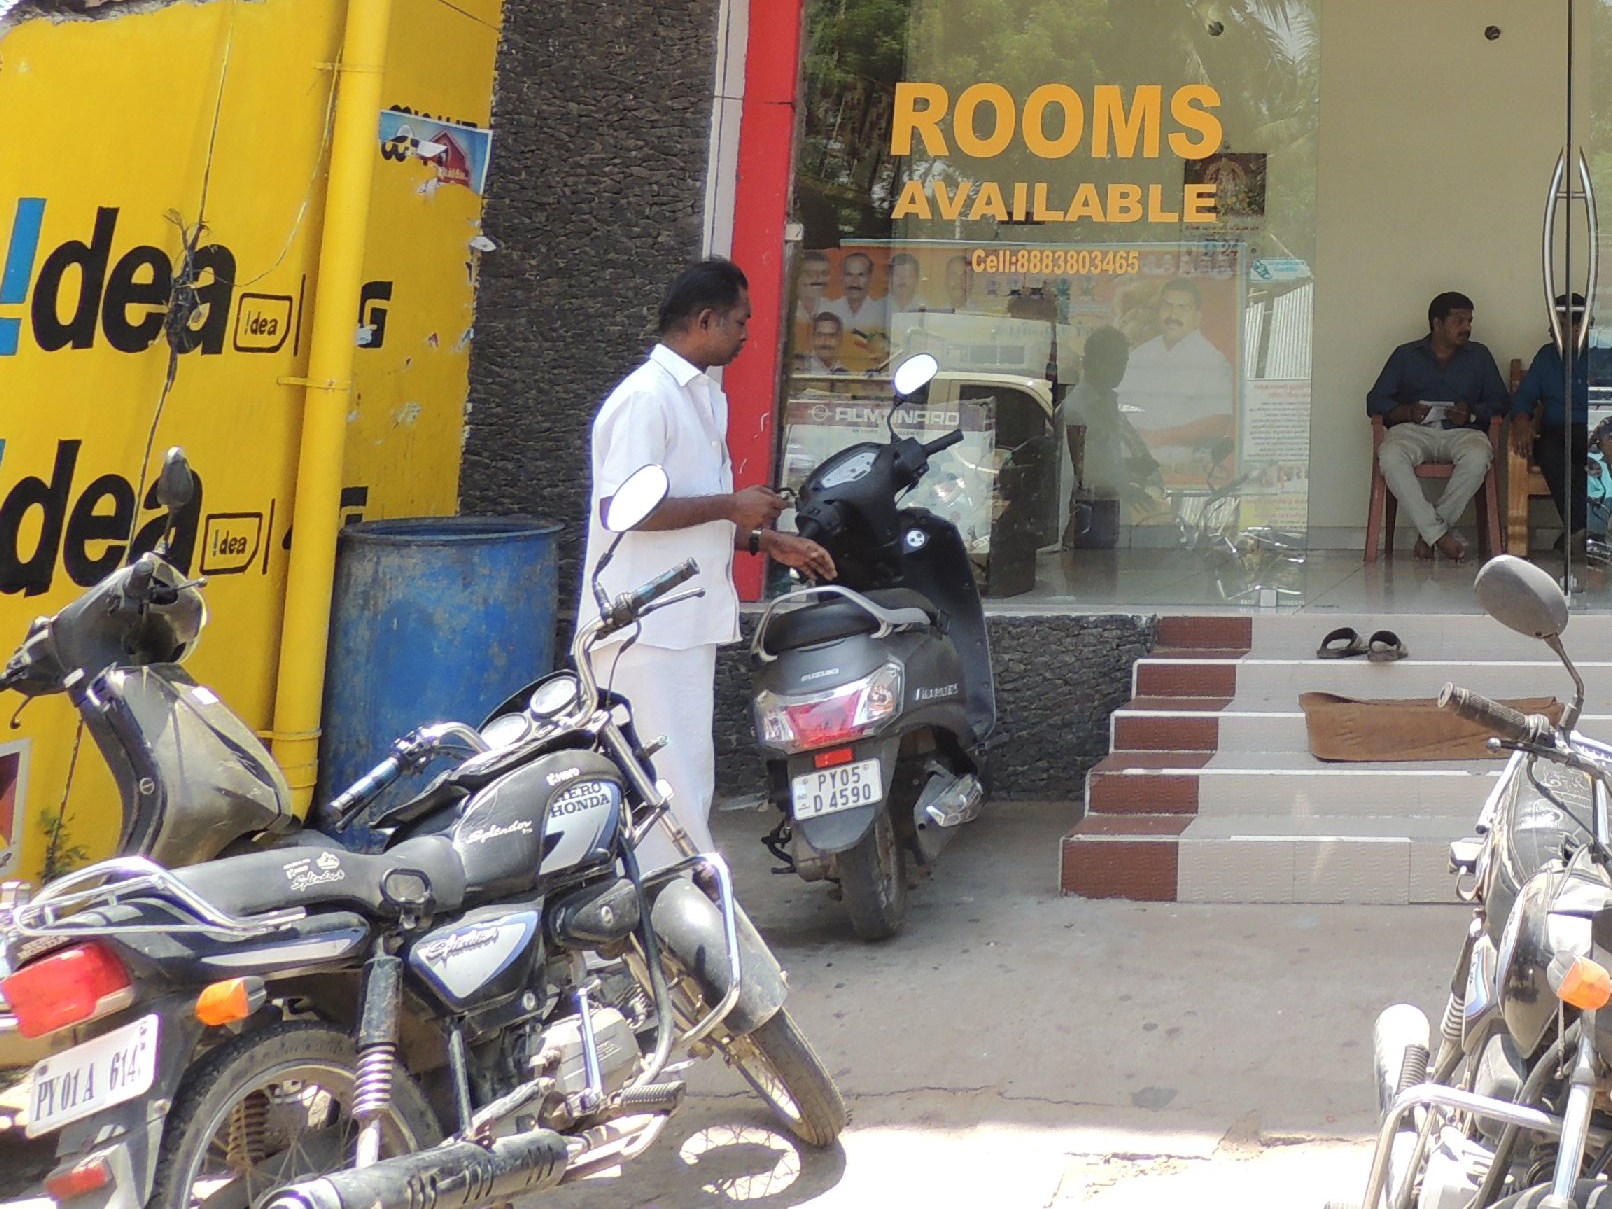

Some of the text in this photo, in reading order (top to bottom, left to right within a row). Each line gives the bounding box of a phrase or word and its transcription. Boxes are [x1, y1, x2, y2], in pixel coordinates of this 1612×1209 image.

[889, 82, 1224, 160] ROOMS
[890, 181, 1218, 223] AVAILABLE
[972, 248, 1140, 276] Cell:8883803465
[818, 766, 861, 793] PY05
[550, 793, 611, 819] HONDA
[813, 783, 871, 813] D 4590
